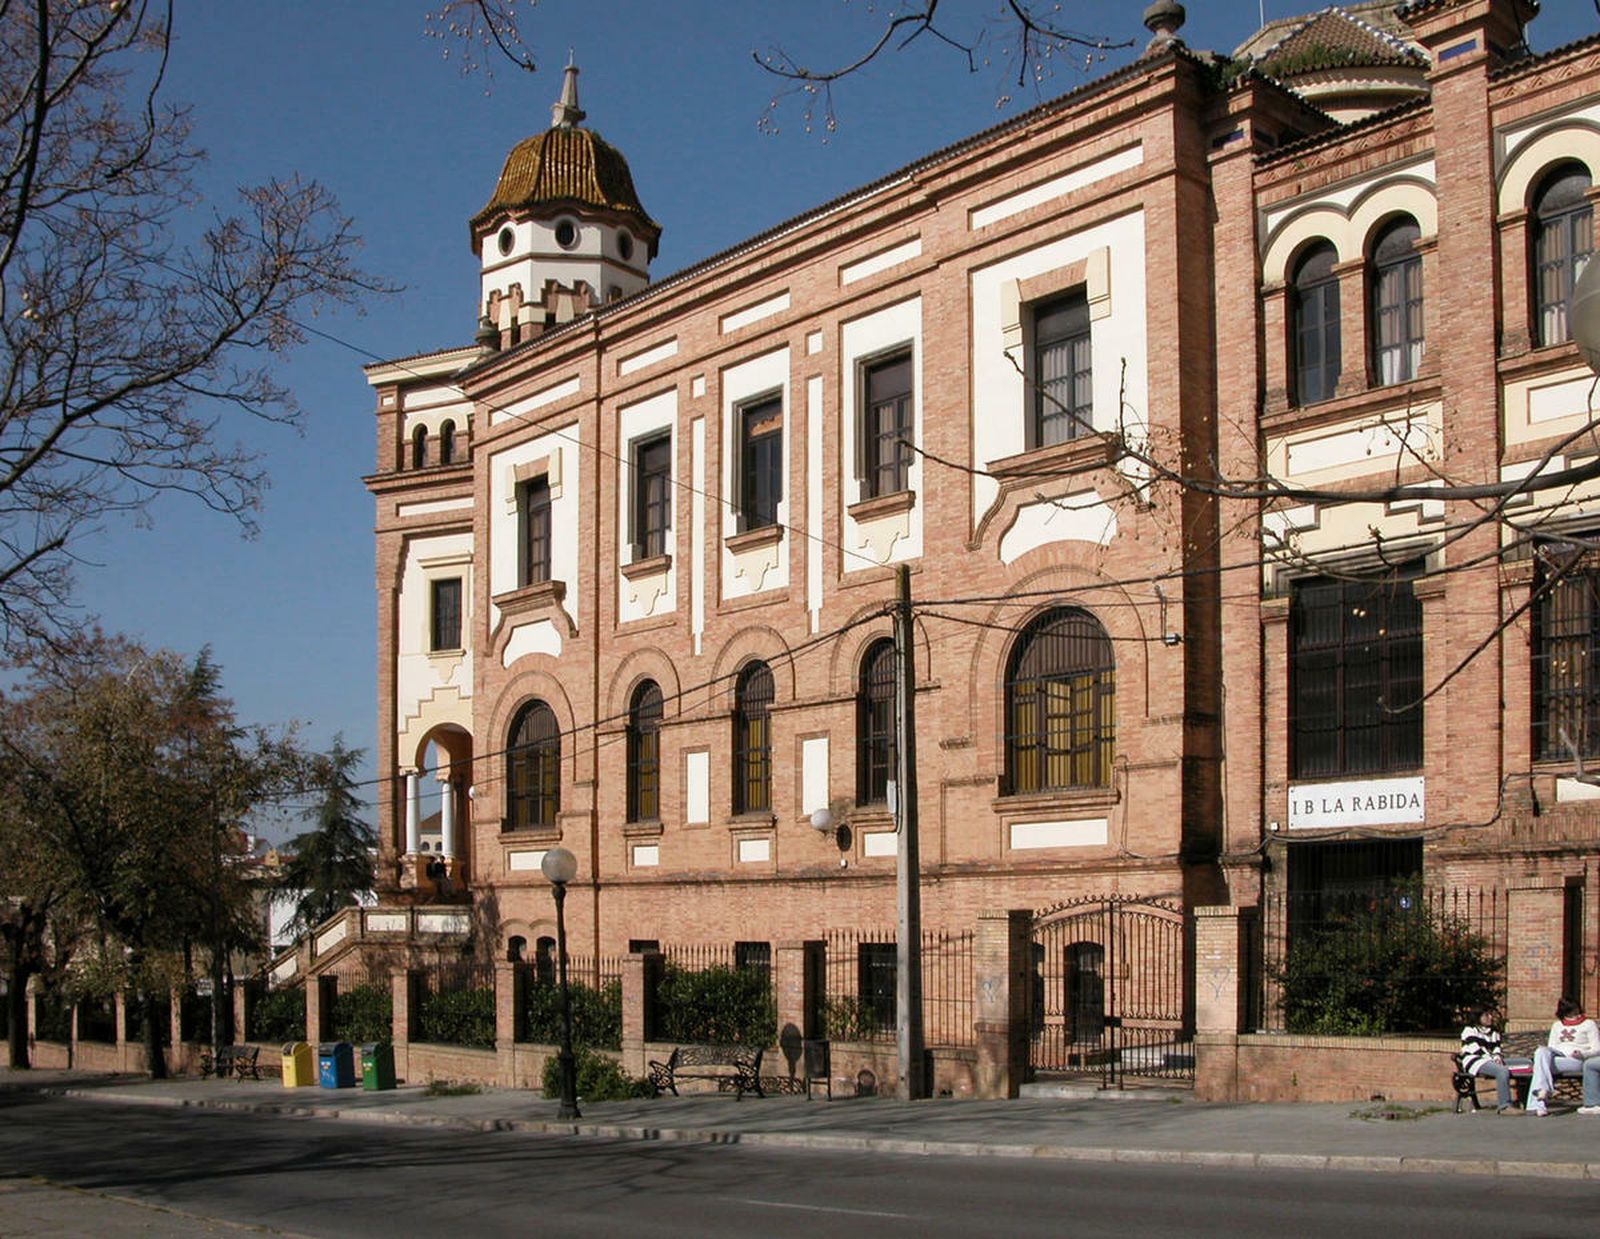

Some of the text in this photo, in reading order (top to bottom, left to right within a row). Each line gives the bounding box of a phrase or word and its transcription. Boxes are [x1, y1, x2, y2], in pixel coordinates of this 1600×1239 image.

[1293, 792, 1421, 815] I B LA RABIDA
